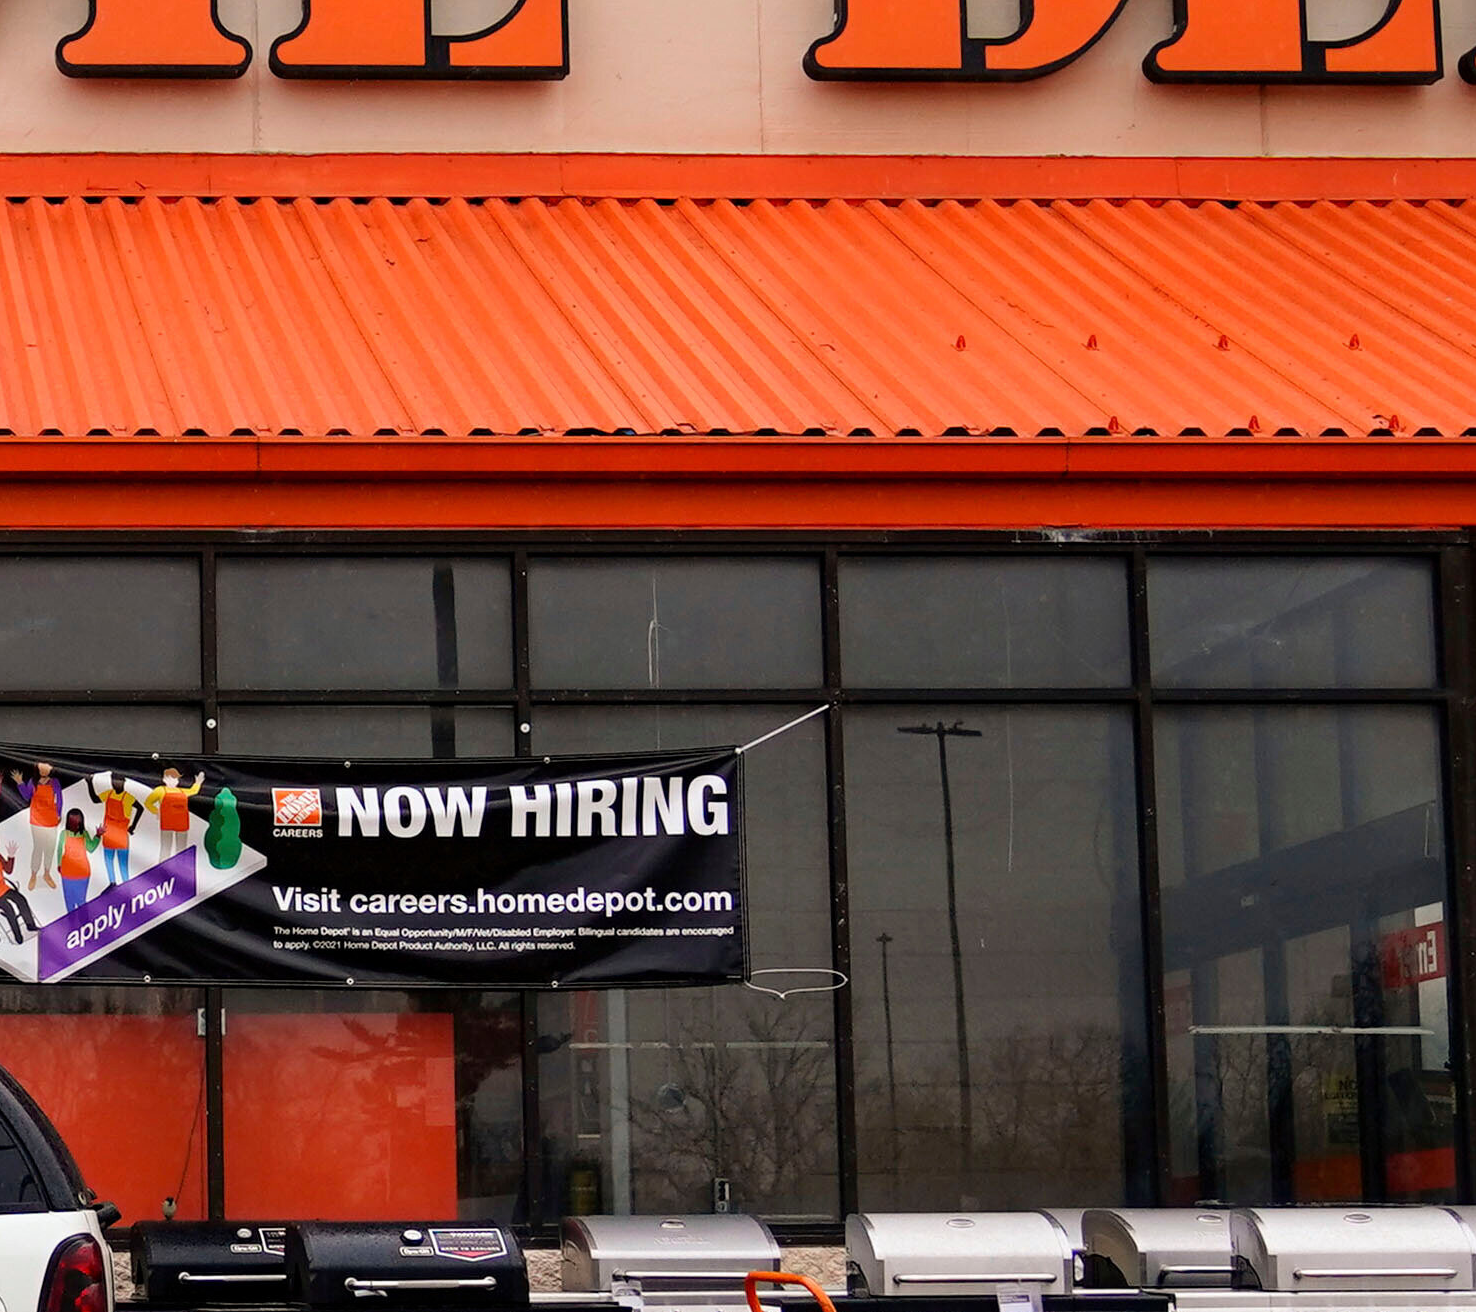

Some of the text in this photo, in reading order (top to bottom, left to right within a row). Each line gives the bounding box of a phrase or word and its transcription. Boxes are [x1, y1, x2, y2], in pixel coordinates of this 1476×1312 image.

[276, 790, 318, 824] HOME
[293, 801, 319, 824] DEPOT
[336, 775, 730, 838] NOW HIRING
[272, 828, 323, 838] CAREERS
[66, 877, 175, 949] apply now
[272, 887, 733, 918] Visit careers.homedepot.com
[274, 926, 291, 936] The
[293, 926, 319, 936] Home
[352, 927, 360, 936] is
[361, 929, 373, 937] an
[375, 928, 400, 938] Equal
[533, 927, 577, 938] Employer.
[578, 927, 615, 938] Bilingual
[616, 927, 664, 936] candidates
[665, 928, 680, 936] are
[681, 926, 734, 937] encouraged
[273, 941, 283, 949] to
[284, 941, 311, 951] apply.
[343, 941, 370, 950] Home
[371, 941, 398, 951] Depot
[399, 941, 433, 950] Product
[434, 941, 474, 952] Authority,
[476, 942, 496, 950] LLC.
[498, 942, 510, 950] All
[511, 941, 536, 952] rights
[537, 942, 576, 950] reserved.
